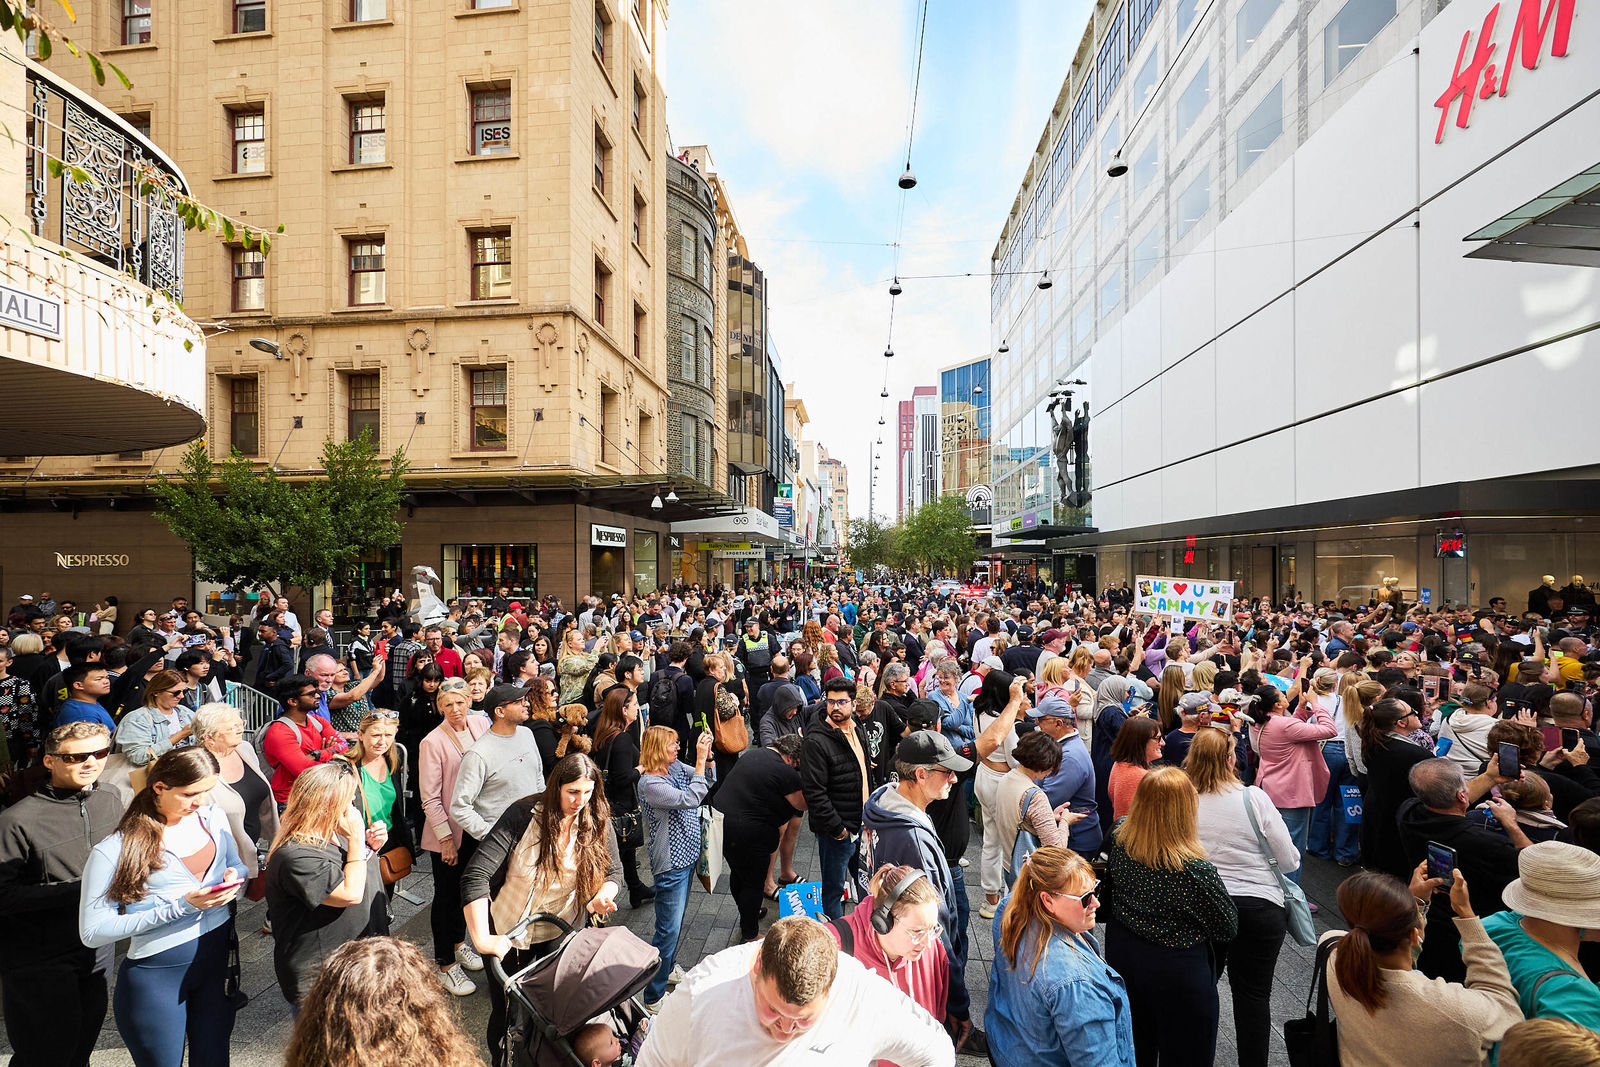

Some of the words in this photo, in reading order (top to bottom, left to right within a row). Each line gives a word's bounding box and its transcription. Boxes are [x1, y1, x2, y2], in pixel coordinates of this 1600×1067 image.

[1433, 0, 1576, 144] H&M
[481, 127, 511, 141] ISES
[0, 291, 52, 327] ALL
[729, 331, 762, 348] DENTST
[595, 527, 626, 544] NESPRESSO
[1440, 538, 1462, 552] H&M
[53, 551, 130, 569] NESPRESSO
[1153, 580, 1168, 594] WE
[1193, 584, 1204, 597] U
[1149, 596, 1209, 615] SAMMY
[1346, 804, 1363, 817] GO
